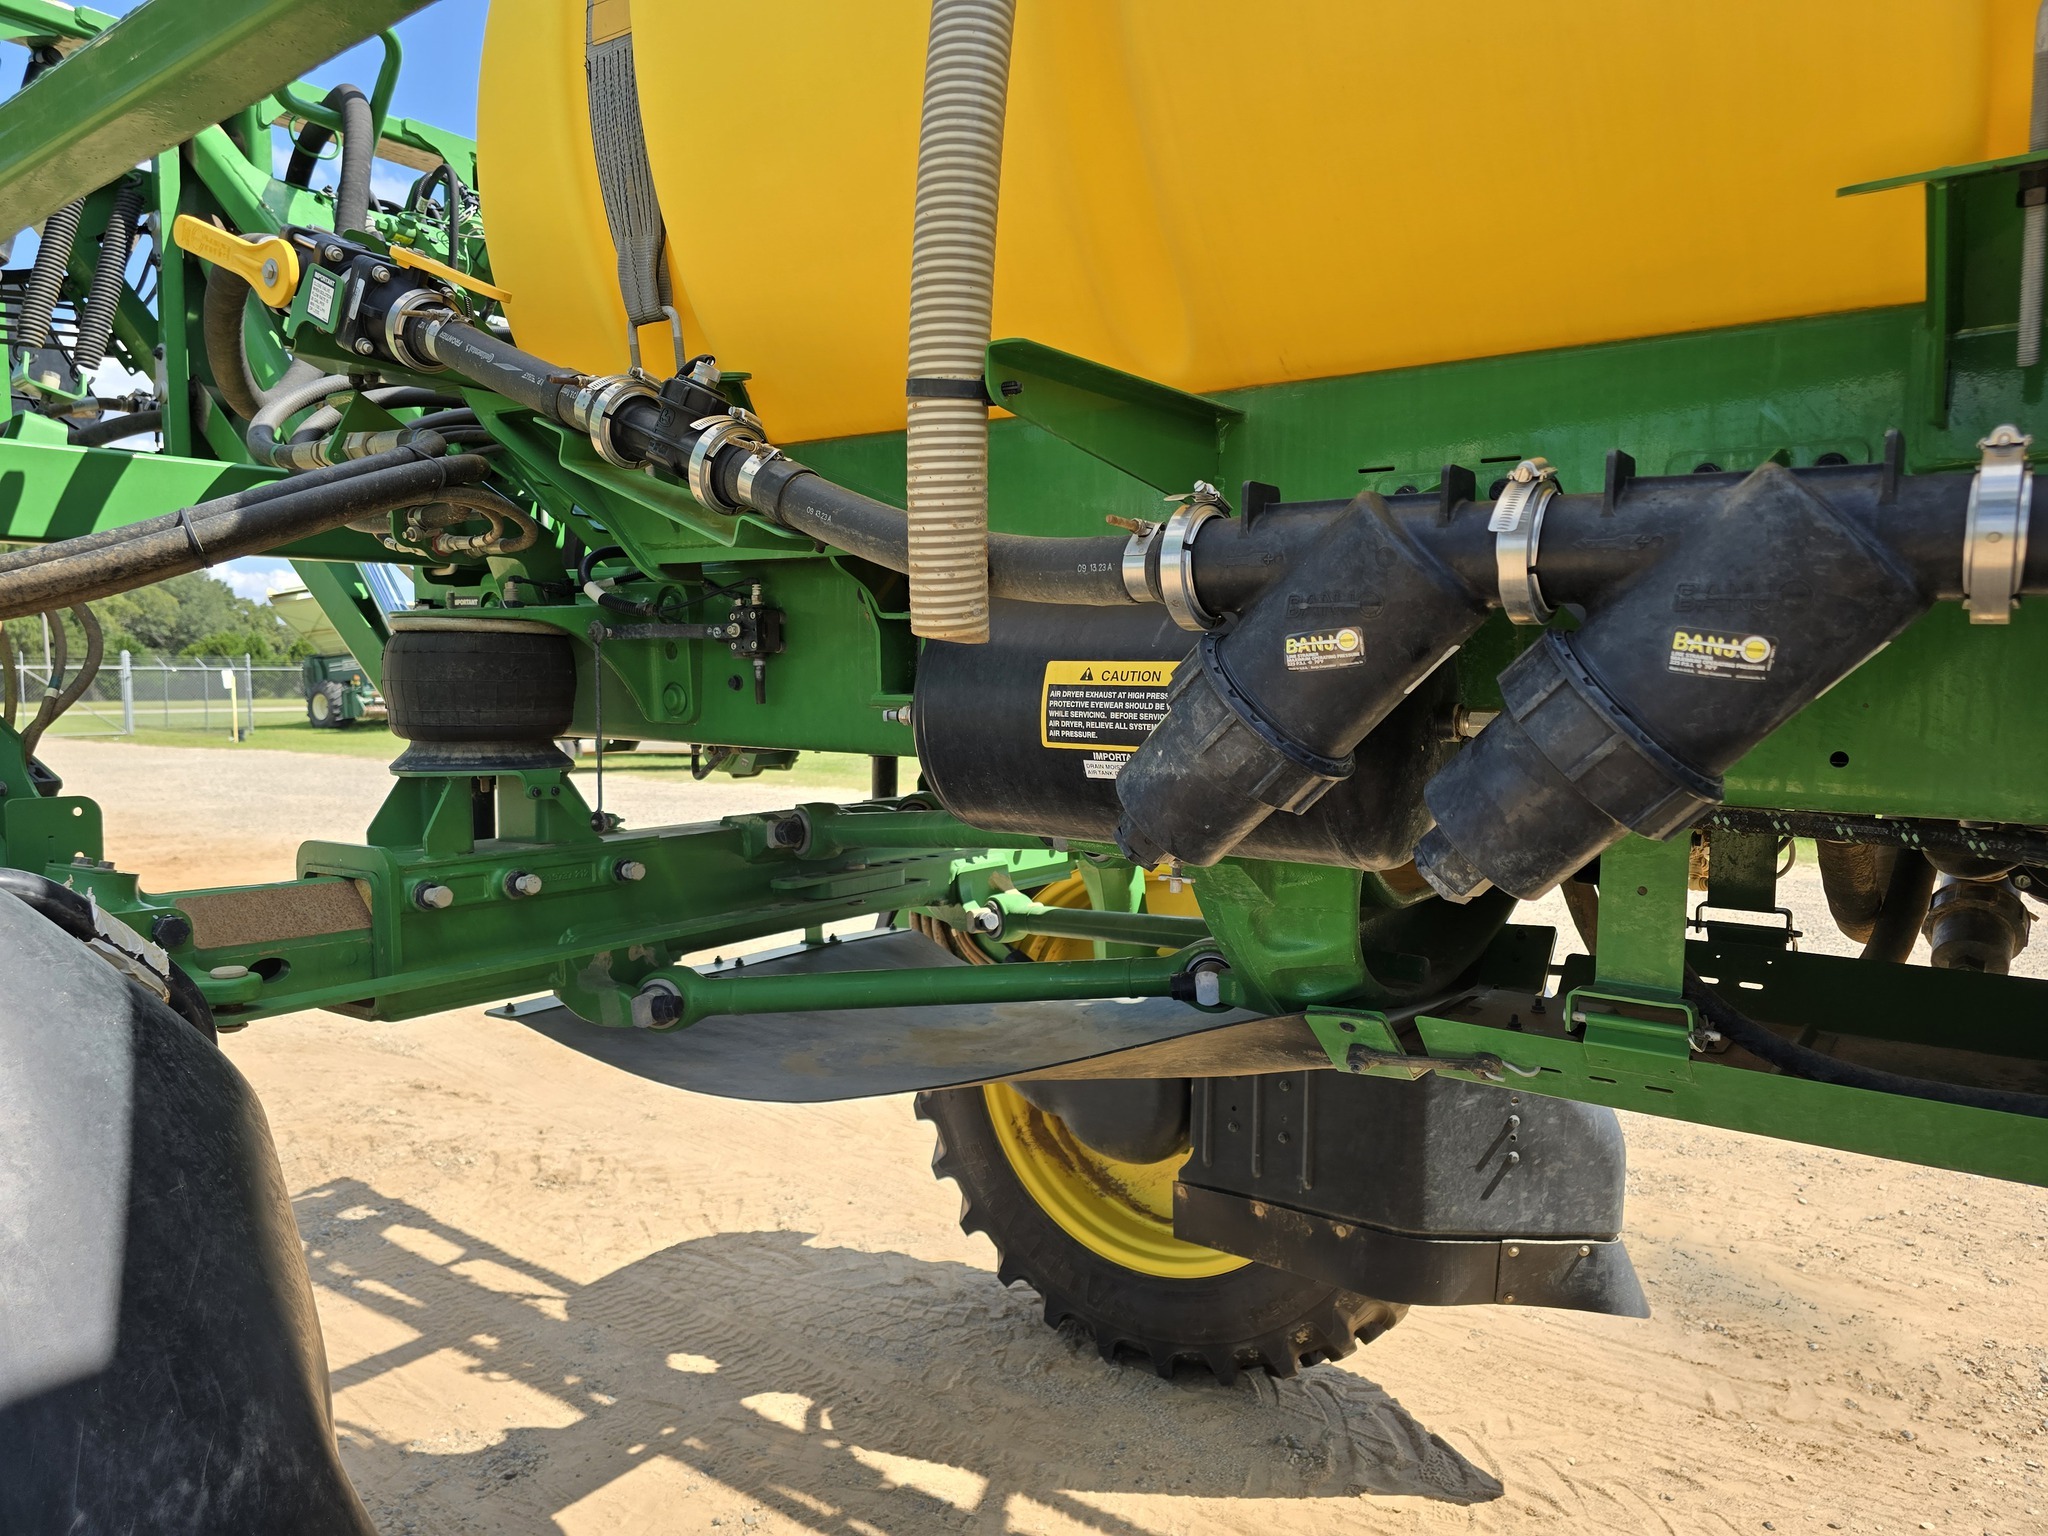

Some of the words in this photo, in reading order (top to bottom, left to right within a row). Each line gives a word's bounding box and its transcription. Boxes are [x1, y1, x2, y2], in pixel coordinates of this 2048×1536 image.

[438, 330, 463, 348] FRONTIER
[1286, 629, 1359, 654] BANJO
[1672, 631, 1771, 663] BANJO
[1101, 670, 1162, 682] CAUTION
[1139, 712, 1167, 721] SERVIC
[1061, 721, 1084, 729] DRYER,
[1061, 730, 1098, 738] PRESSURE.
